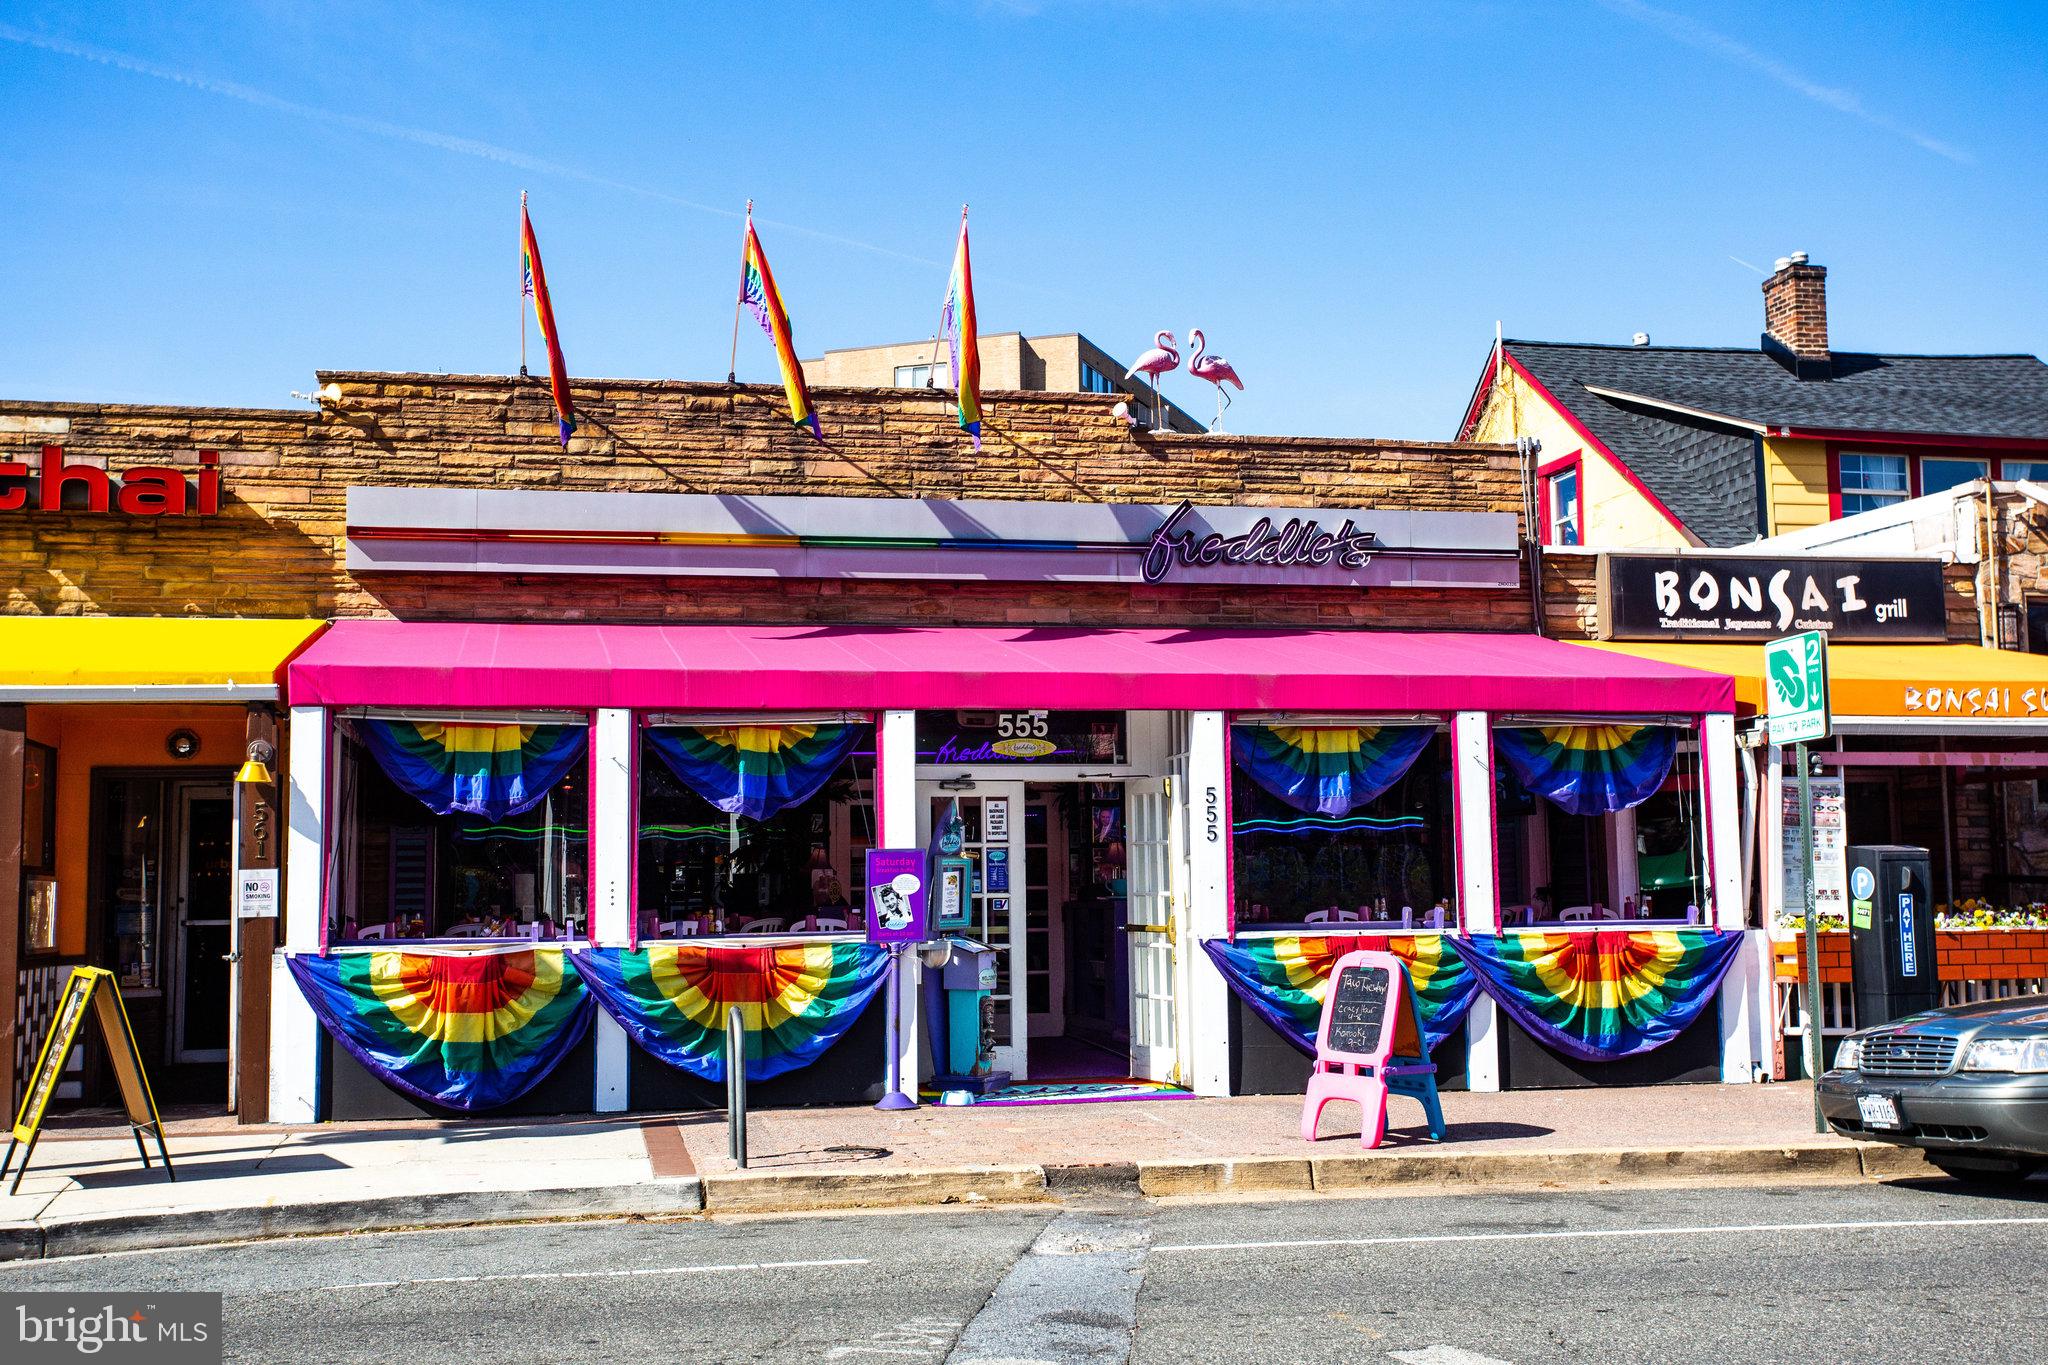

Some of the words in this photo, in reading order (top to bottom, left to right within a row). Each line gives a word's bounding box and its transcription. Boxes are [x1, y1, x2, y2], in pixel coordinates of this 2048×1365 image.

[1140, 498, 1376, 584] freddie's
[1654, 568, 1868, 632] BONSAI
[1874, 598, 1909, 623] grill
[1659, 617, 1721, 629] Traditional
[1724, 619, 1772, 630] Japanese
[1794, 619, 1834, 630] Cuisine
[1806, 639, 1820, 667] 2
[1904, 686, 2011, 716] BONSAI
[997, 713, 1049, 738] 555
[1205, 786, 1218, 842] 555
[253, 801, 268, 859] 561
[875, 858, 916, 868] Saturday
[245, 882, 259, 891] NO
[1856, 872, 1869, 895] P
[1902, 897, 1911, 928] PAY
[1903, 932, 1914, 973] HERE
[1342, 974, 1361, 989] Taco
